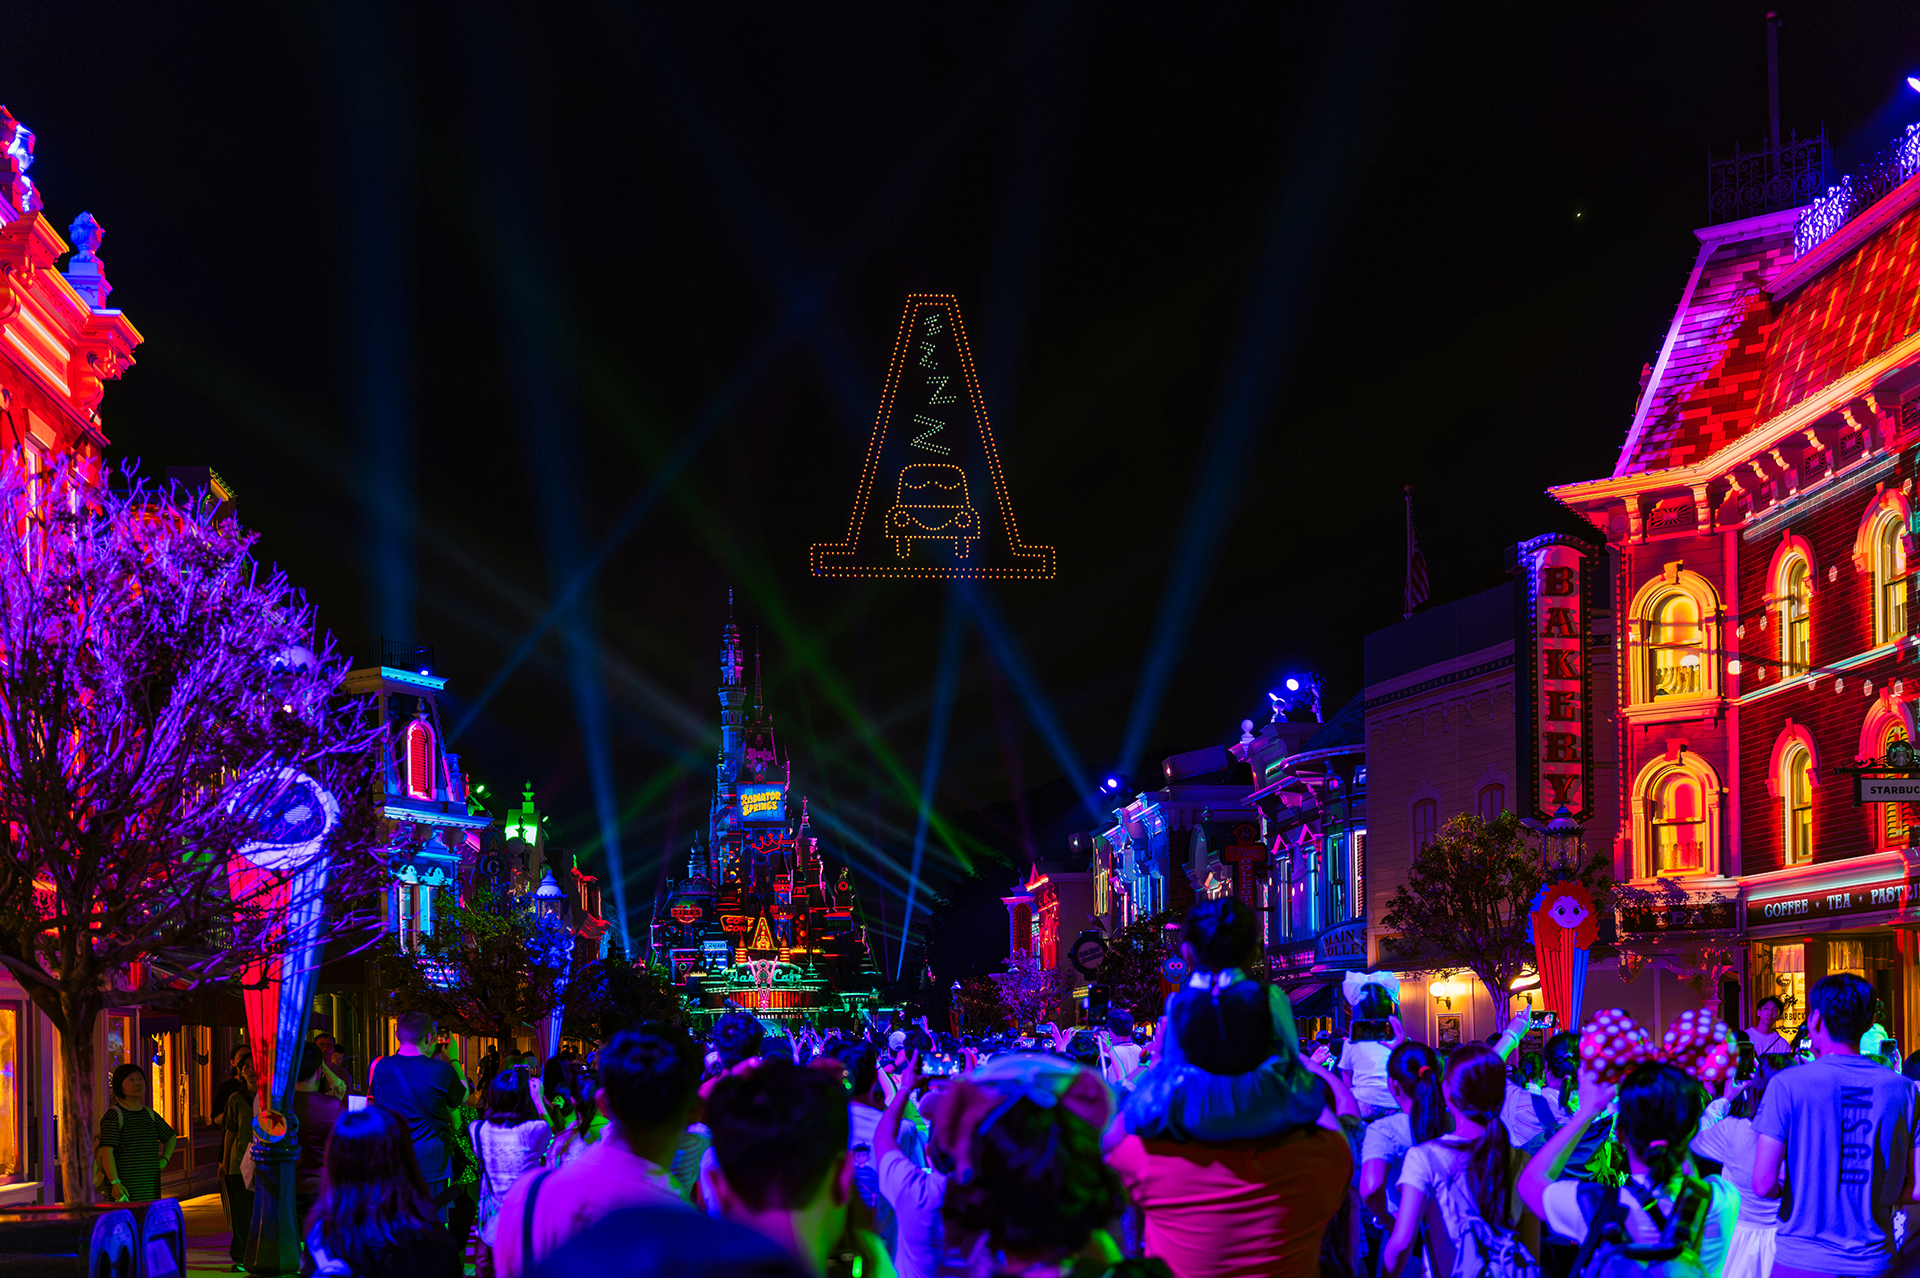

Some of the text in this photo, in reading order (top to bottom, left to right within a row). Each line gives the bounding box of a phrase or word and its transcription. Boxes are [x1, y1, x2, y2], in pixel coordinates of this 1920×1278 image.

[1540, 565, 1582, 807] BAKERY
[1870, 786, 1920, 794] STARBUC
[741, 791, 782, 806] RADIATOR
[742, 801, 778, 816] SPRINGS
[1764, 883, 1920, 918] COFFEE TEA PASTRI
[1324, 929, 1355, 947] MAIN
